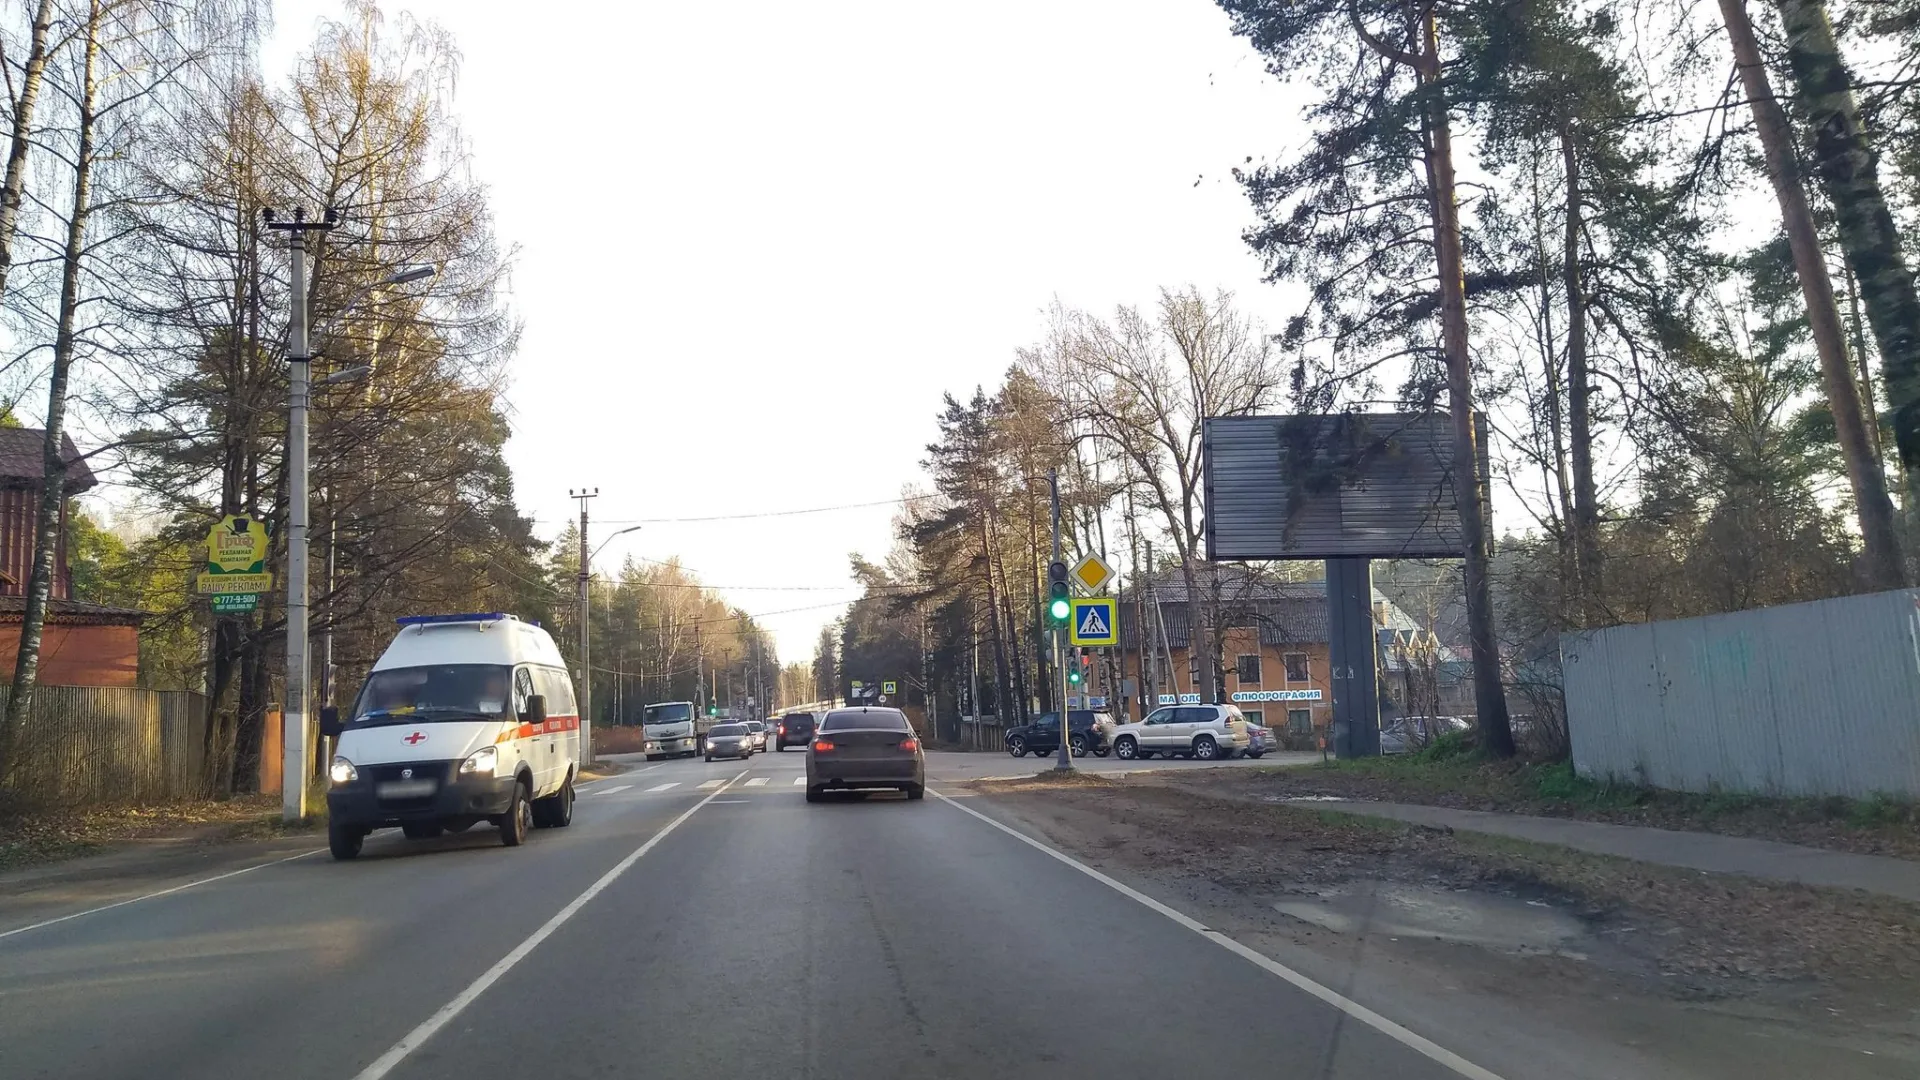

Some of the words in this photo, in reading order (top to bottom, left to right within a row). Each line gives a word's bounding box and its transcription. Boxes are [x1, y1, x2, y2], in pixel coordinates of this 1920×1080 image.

[202, 583, 225, 592] ВАШУ
[228, 582, 267, 591] РЕКЛАМУ
[221, 595, 256, 603] 777-9-500
[1233, 691, 1320, 701] ФЛЮОРОГРАФИЯ
